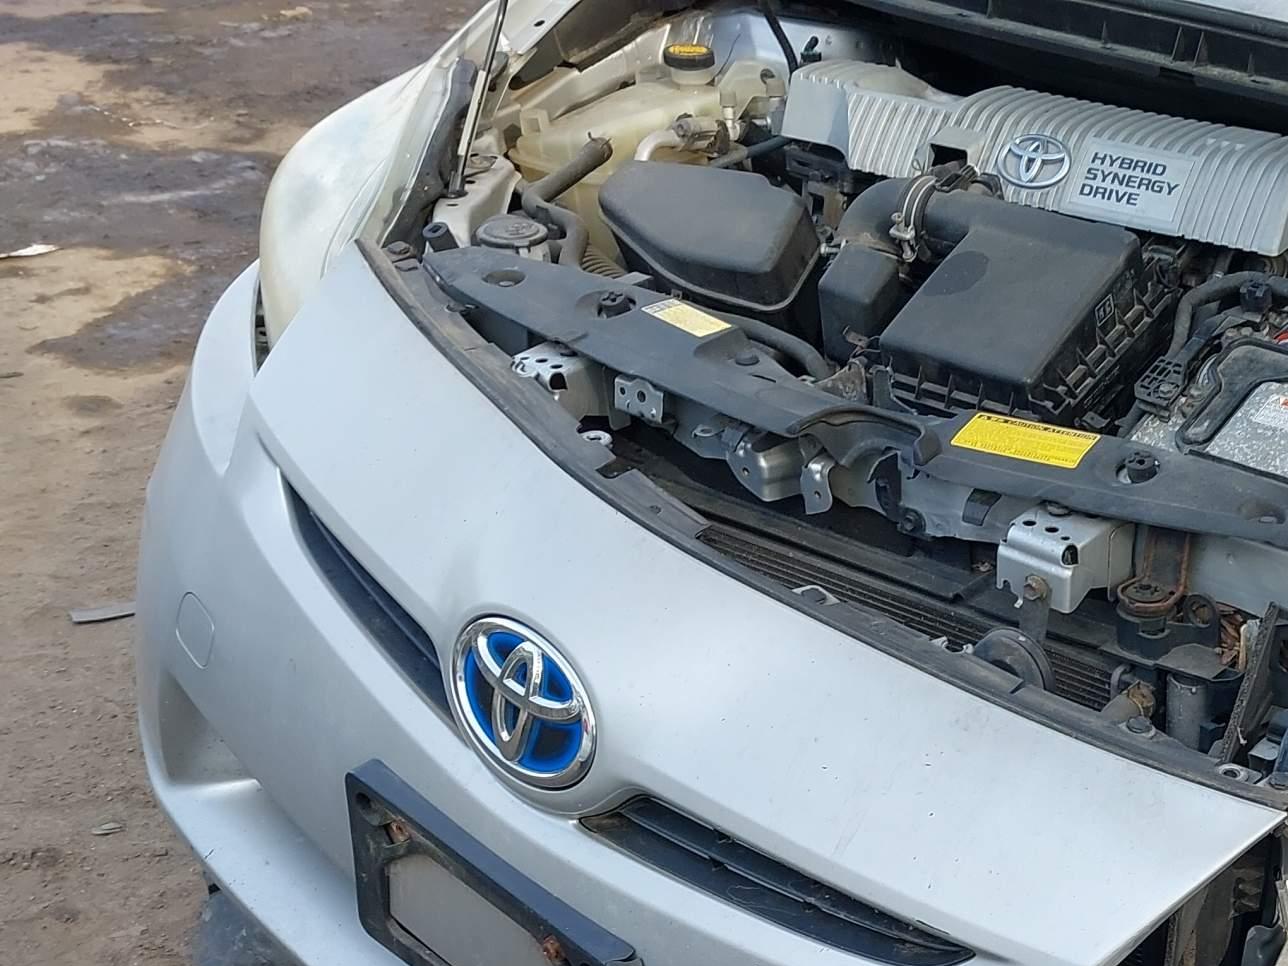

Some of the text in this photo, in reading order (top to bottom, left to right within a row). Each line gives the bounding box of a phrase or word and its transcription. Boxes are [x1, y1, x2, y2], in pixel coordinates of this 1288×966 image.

[1091, 152, 1167, 176] HYBRID
[1085, 167, 1179, 195] SYNERGY
[1079, 183, 1140, 206] DRIVE
